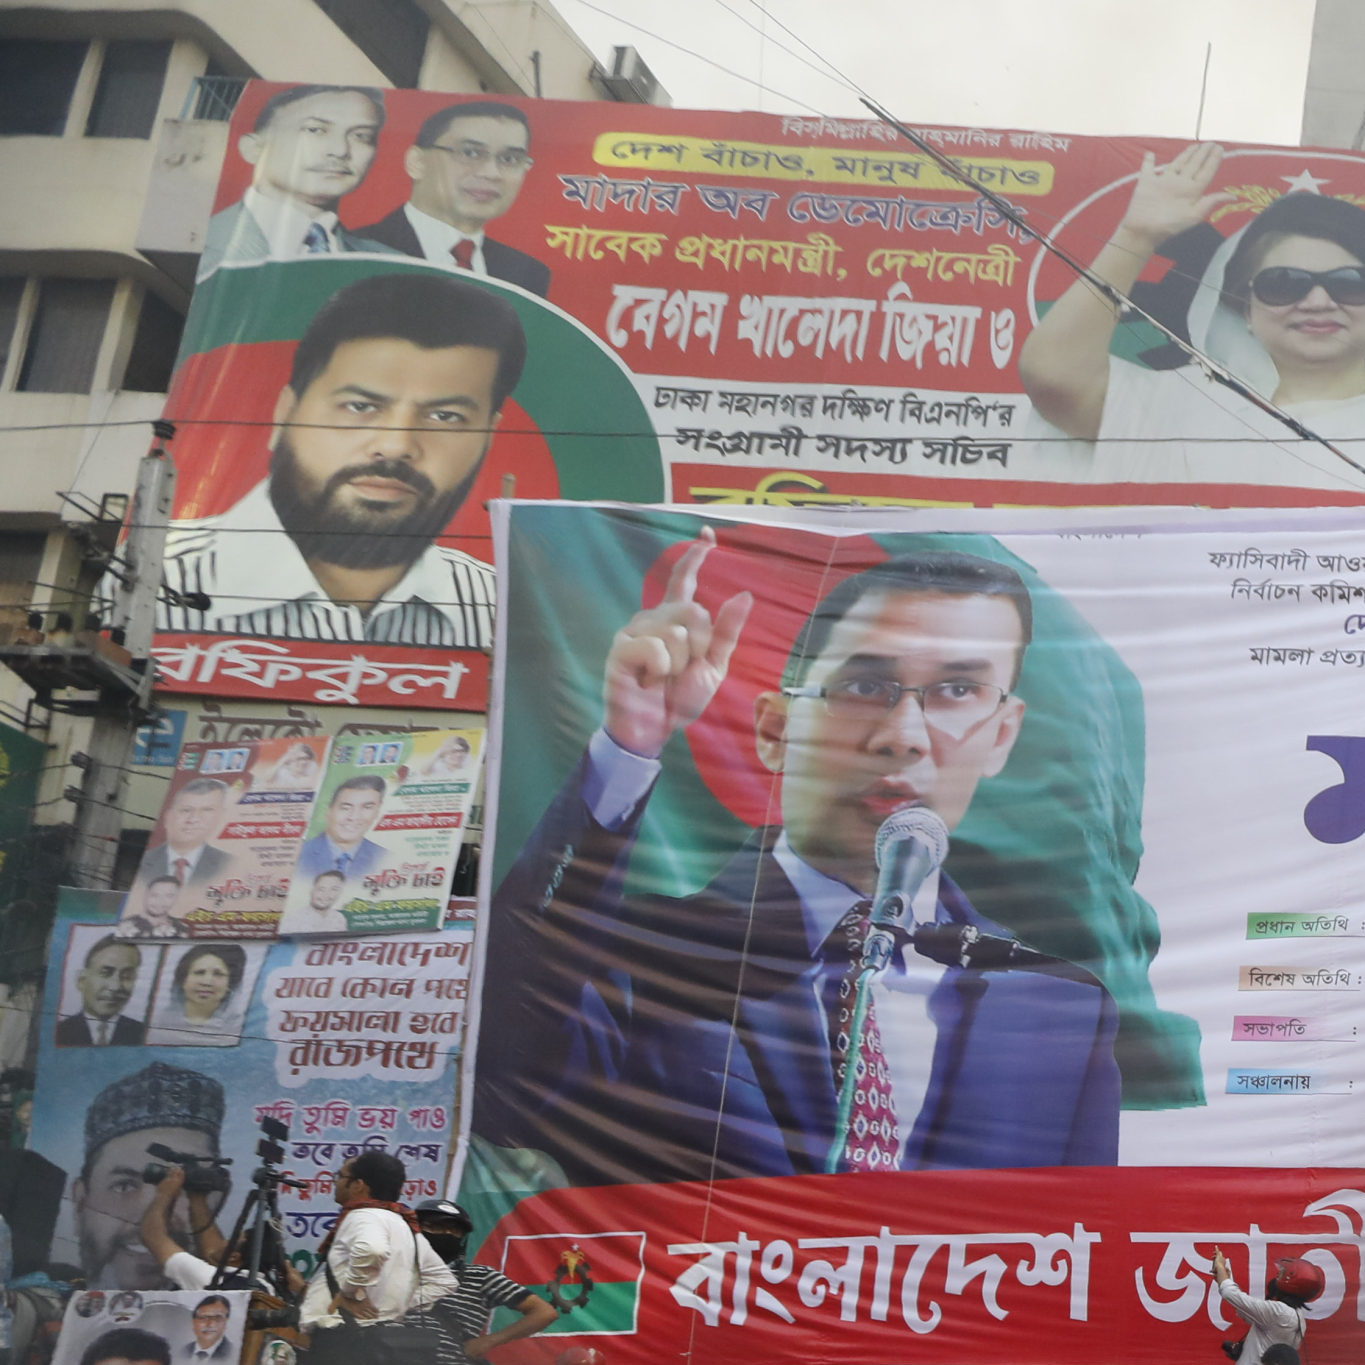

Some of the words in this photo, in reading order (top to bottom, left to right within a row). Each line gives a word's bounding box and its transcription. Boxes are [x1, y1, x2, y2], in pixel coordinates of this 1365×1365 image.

[611, 138, 690, 163] দেশ
[702, 138, 815, 178] বাঁচাও,
[832, 153, 922, 186] মানুষ
[558, 173, 690, 216] মাদার
[697, 182, 778, 224] অব
[544, 224, 667, 265] সাবেক
[675, 231, 849, 282] প্রধানমন্ত্রী,
[866, 243, 1022, 288] দেশনেত্রী
[605, 283, 730, 358] বেগম
[736, 291, 878, 363] খালেদা
[879, 282, 982, 369] জিয়া
[989, 304, 1017, 370] ও
[655, 386, 708, 416] ঢাকা
[718, 390, 816, 420] মহানগর
[821, 388, 895, 425] দক্ষিণ
[675, 423, 806, 459] সংগ্রামী
[815, 436, 912, 469] সদস্য
[922, 434, 1014, 469] সচিব
[1208, 547, 1310, 572] ফ্যাসিবাদী
[1230, 577, 1303, 602] নির্বাচন
[1249, 645, 1315, 667] মামলা
[1254, 913, 1296, 935] প্রধান
[1300, 912, 1350, 934] অতিথি
[304, 941, 474, 968] বাংলাদেশ
[274, 975, 337, 1000] যাবে
[339, 975, 418, 1001] কোন
[1248, 967, 1296, 988] বিশেষ
[1300, 967, 1352, 988] অতিথি
[278, 1008, 403, 1039] ফয়সালা
[407, 1010, 460, 1036] হবে
[1242, 1018, 1309, 1039] সভাপতি
[287, 1038, 442, 1077] রাজপথে
[301, 1100, 352, 1136] তুমি
[356, 1106, 399, 1131] ভয়
[407, 1105, 448, 1130] পাও
[290, 1141, 338, 1167] তবে
[393, 1143, 445, 1164] শেষ
[666, 1221, 1102, 1336] বাংলাদেশ
